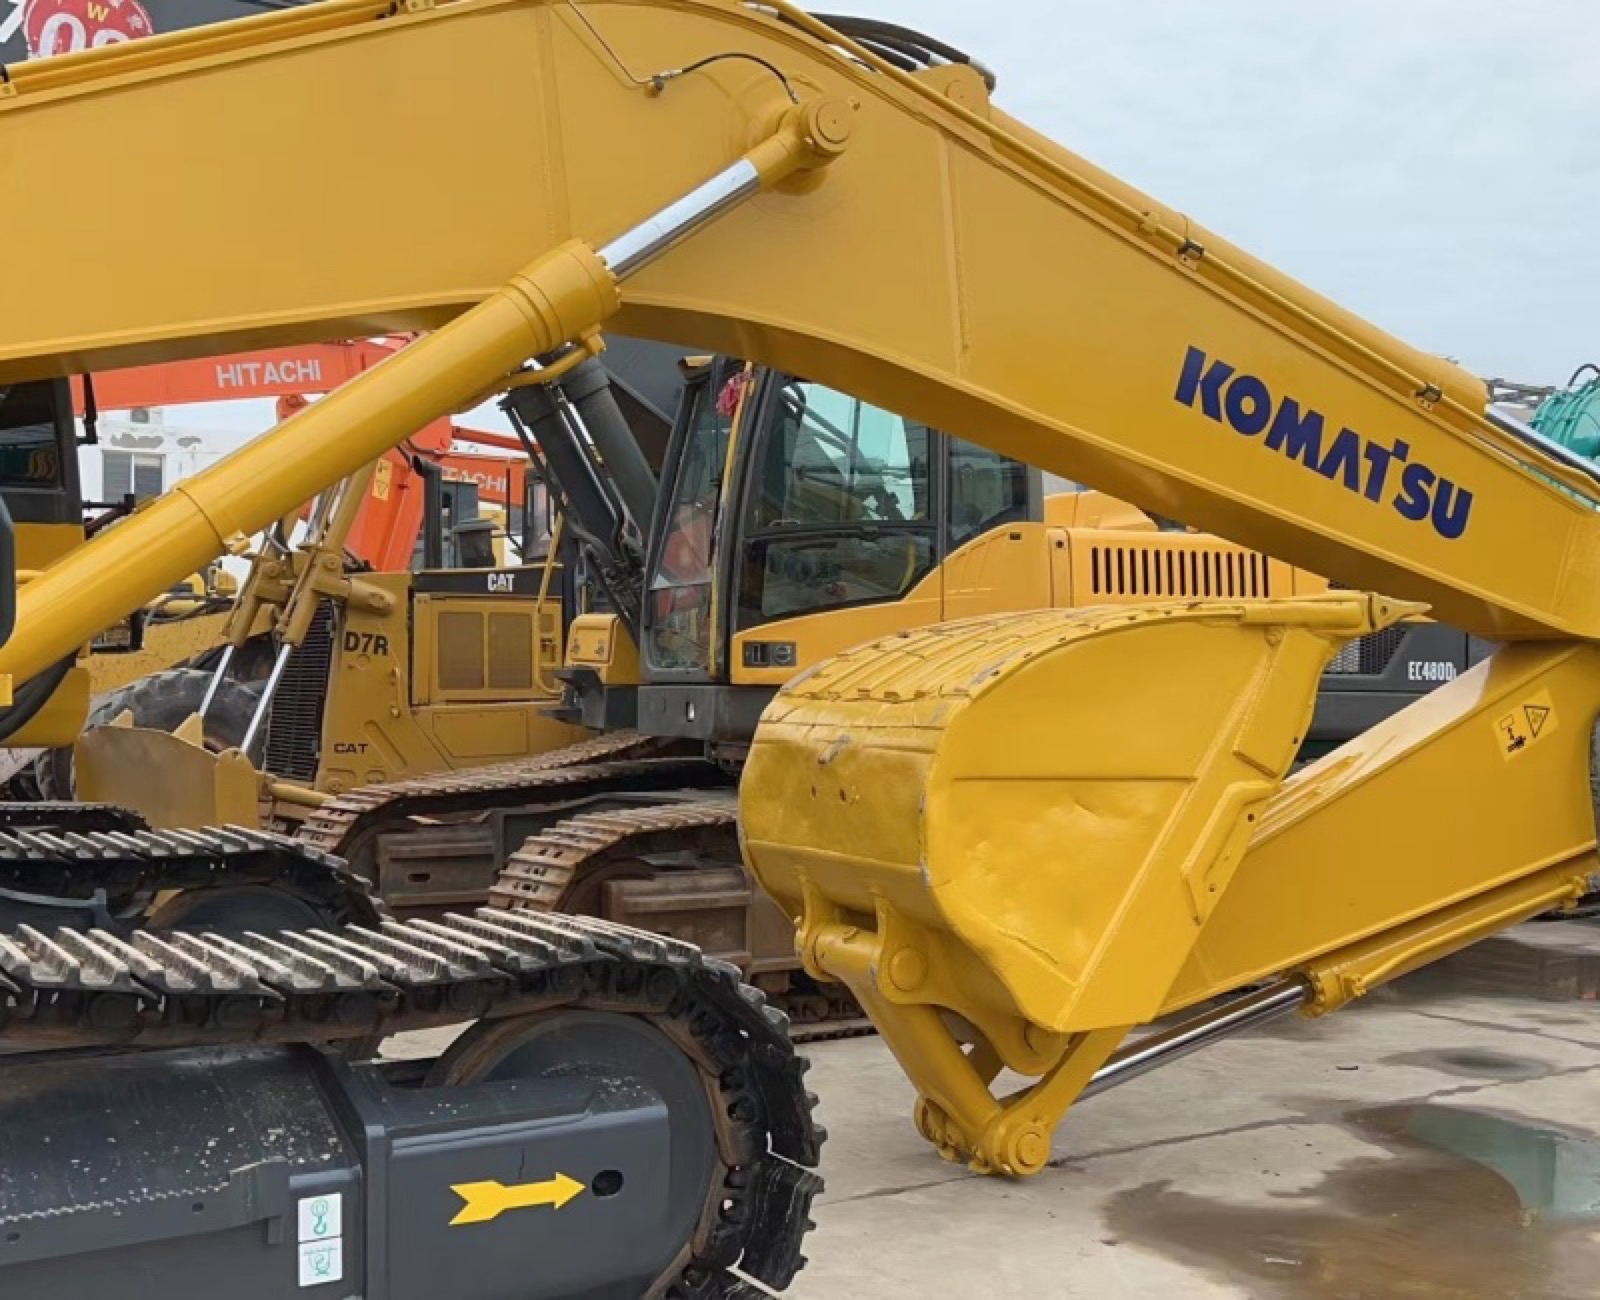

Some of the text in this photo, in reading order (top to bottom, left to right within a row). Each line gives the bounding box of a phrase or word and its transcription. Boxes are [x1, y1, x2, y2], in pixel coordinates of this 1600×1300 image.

[215, 359, 321, 388] HITACHI
[1174, 344, 1473, 539] KOMATSU
[487, 573, 515, 591] CAT
[344, 631, 389, 656] D7R
[333, 743, 369, 754] CAT
